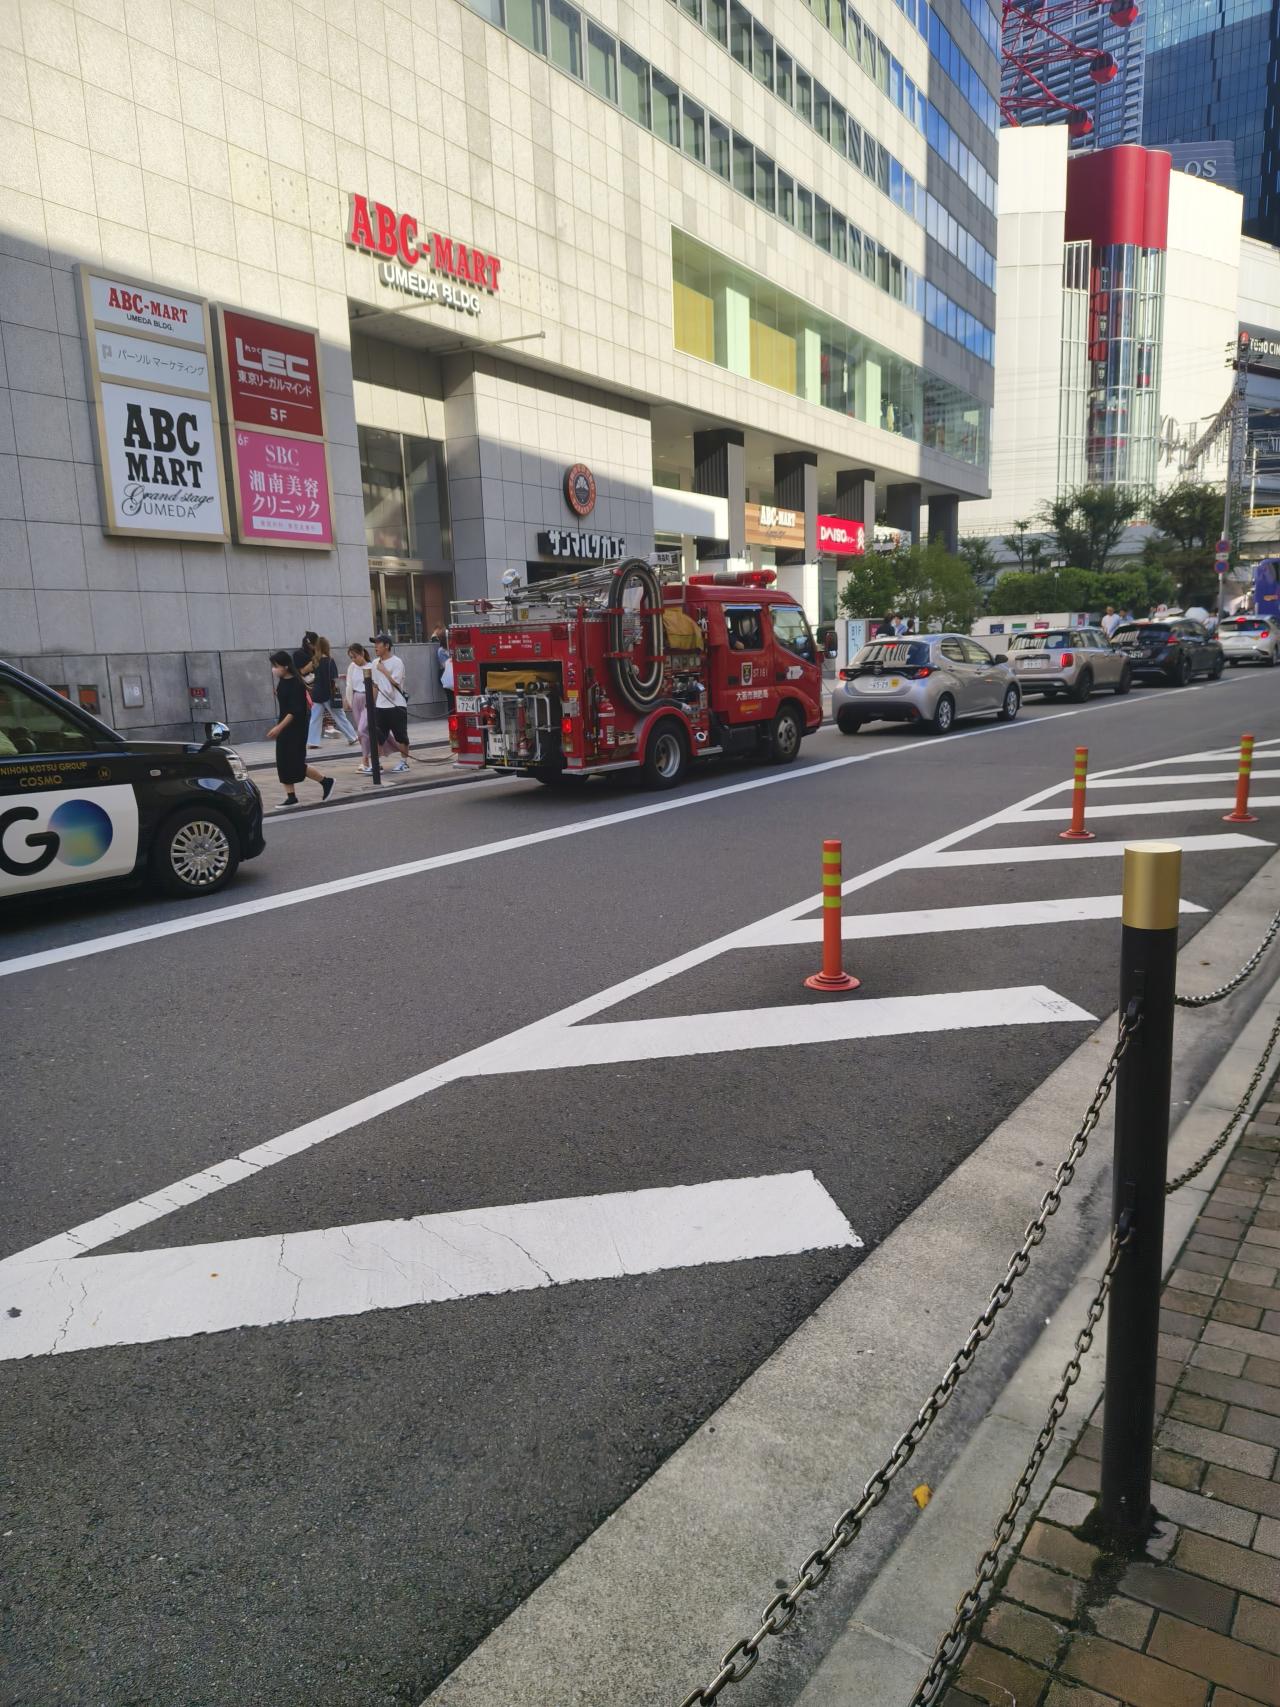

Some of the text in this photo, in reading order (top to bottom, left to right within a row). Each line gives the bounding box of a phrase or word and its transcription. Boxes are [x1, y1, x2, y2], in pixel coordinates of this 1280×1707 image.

[350, 192, 501, 292] ABC-MART
[382, 262, 483, 313] UMEDA BLDG.
[108, 287, 188, 324] ABC-MART
[126, 314, 152, 326] UMEDA
[118, 348, 205, 376] パーソル マーケティング
[235, 337, 310, 381] LEC
[237, 369, 312, 397] 東京リーガルマインド
[270, 408, 287, 422] 5F
[124, 403, 200, 456] ABC
[238, 434, 248, 446] 6F
[265, 445, 299, 466] SBC
[125, 452, 203, 488] MART
[249, 470, 319, 498] 湘南美容
[121, 483, 214, 517] Grand stage
[144, 503, 196, 519] UMEDA
[252, 494, 320, 519] クリニック
[820, 526, 847, 543] DAISO
[0, 762, 88, 777] NIHON KOTSU GROUP
[20, 775, 63, 788] COSMO
